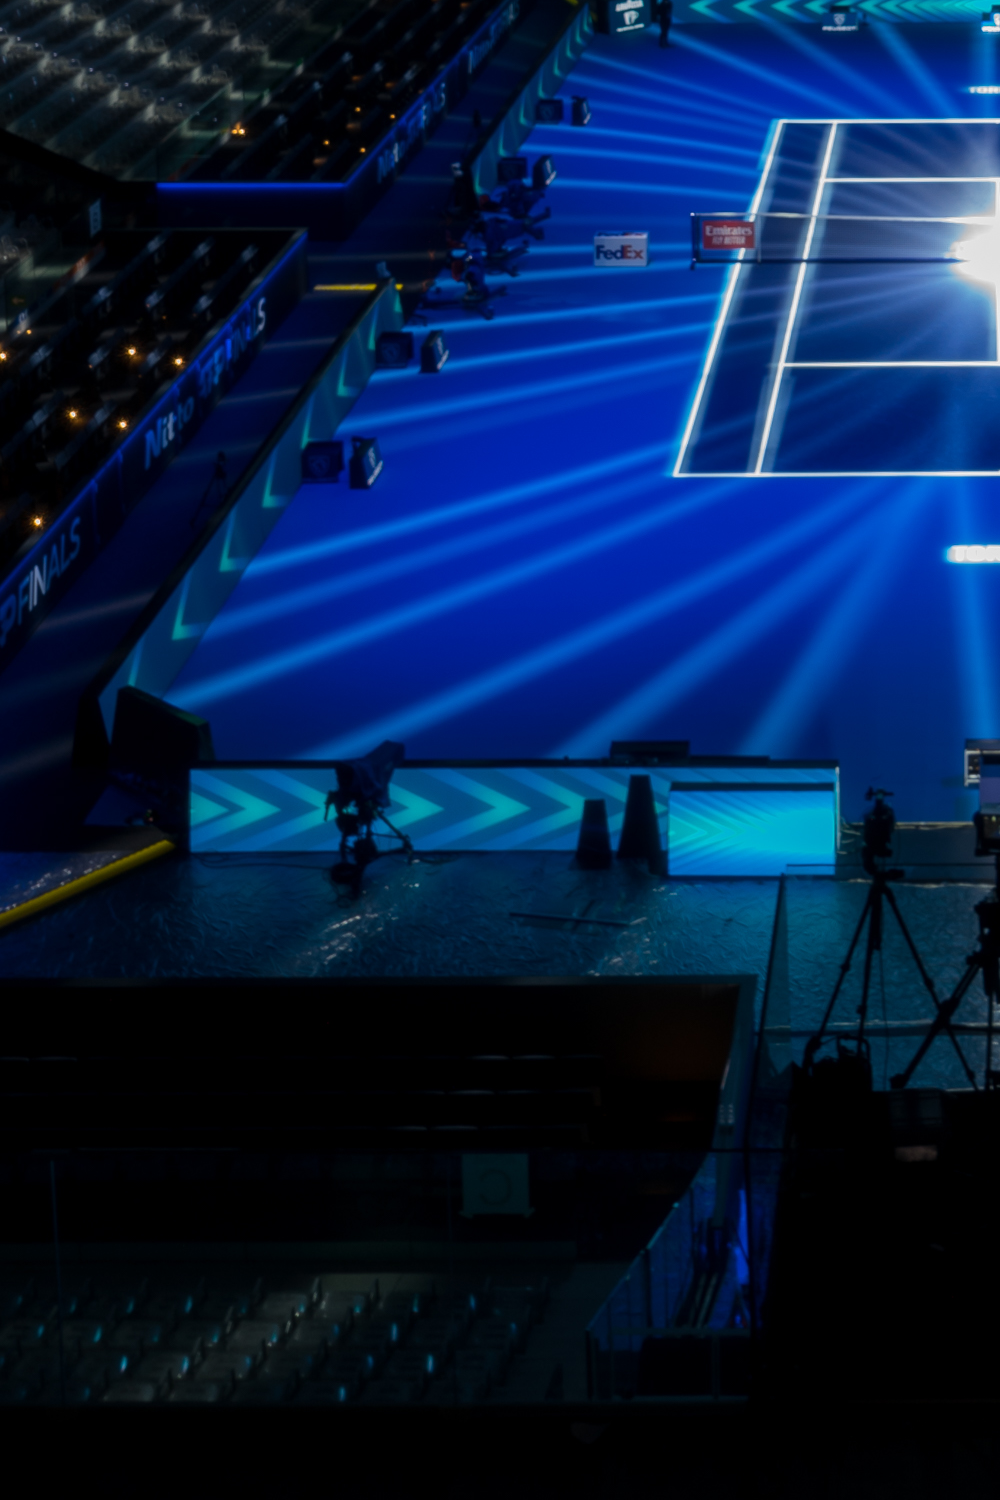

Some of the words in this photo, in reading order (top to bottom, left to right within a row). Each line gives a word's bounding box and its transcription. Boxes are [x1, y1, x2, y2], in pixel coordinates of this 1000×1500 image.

[595, 244, 644, 260] FedEx
[705, 224, 752, 236] Emirates
[144, 396, 196, 471] Nitto
[17, 515, 82, 627] FINALS
